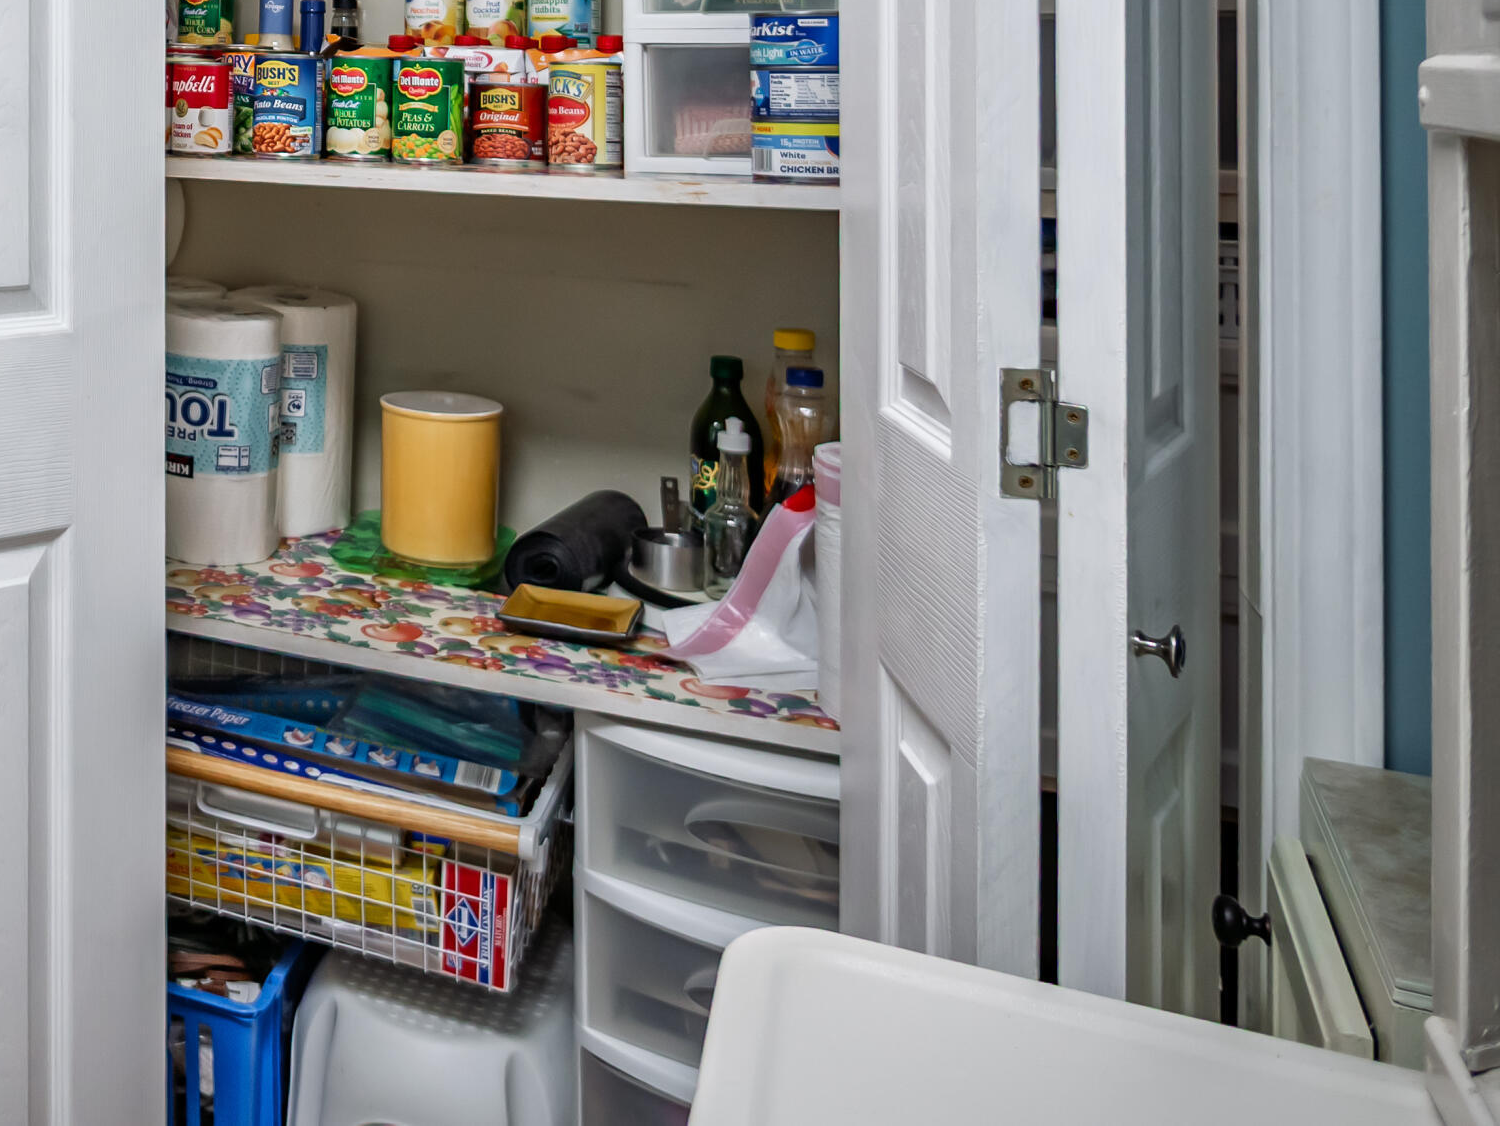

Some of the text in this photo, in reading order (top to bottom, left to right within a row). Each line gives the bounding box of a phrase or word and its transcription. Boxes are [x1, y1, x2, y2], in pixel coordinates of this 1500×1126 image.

[265, 0, 285, 13] Kroger
[535, 5, 561, 14] tidbits
[196, 25, 216, 34] CORN
[751, 21, 795, 36] arKist
[762, 48, 783, 60] Light
[799, 47, 823, 55] WATER
[226, 54, 255, 73] ORY
[257, 67, 296, 82] BUSH'S
[341, 75, 364, 84] Monte
[173, 75, 215, 95] mpbell's
[400, 76, 439, 86] Del Monte
[550, 78, 585, 97] UCK'S
[482, 94, 516, 106] BUSH'S
[273, 99, 304, 112] Beans
[558, 106, 585, 115] Beans
[334, 108, 356, 118] WHOLE
[402, 112, 433, 122] PEAS &
[479, 112, 520, 122] Original
[336, 118, 371, 128] POTATOES
[397, 122, 435, 132] CARROTS
[780, 151, 806, 159] White
[780, 165, 839, 174] CHICKEN BR
[167, 426, 197, 441] PRE
[167, 463, 190, 474] KIR
[210, 707, 250, 725] Paper
